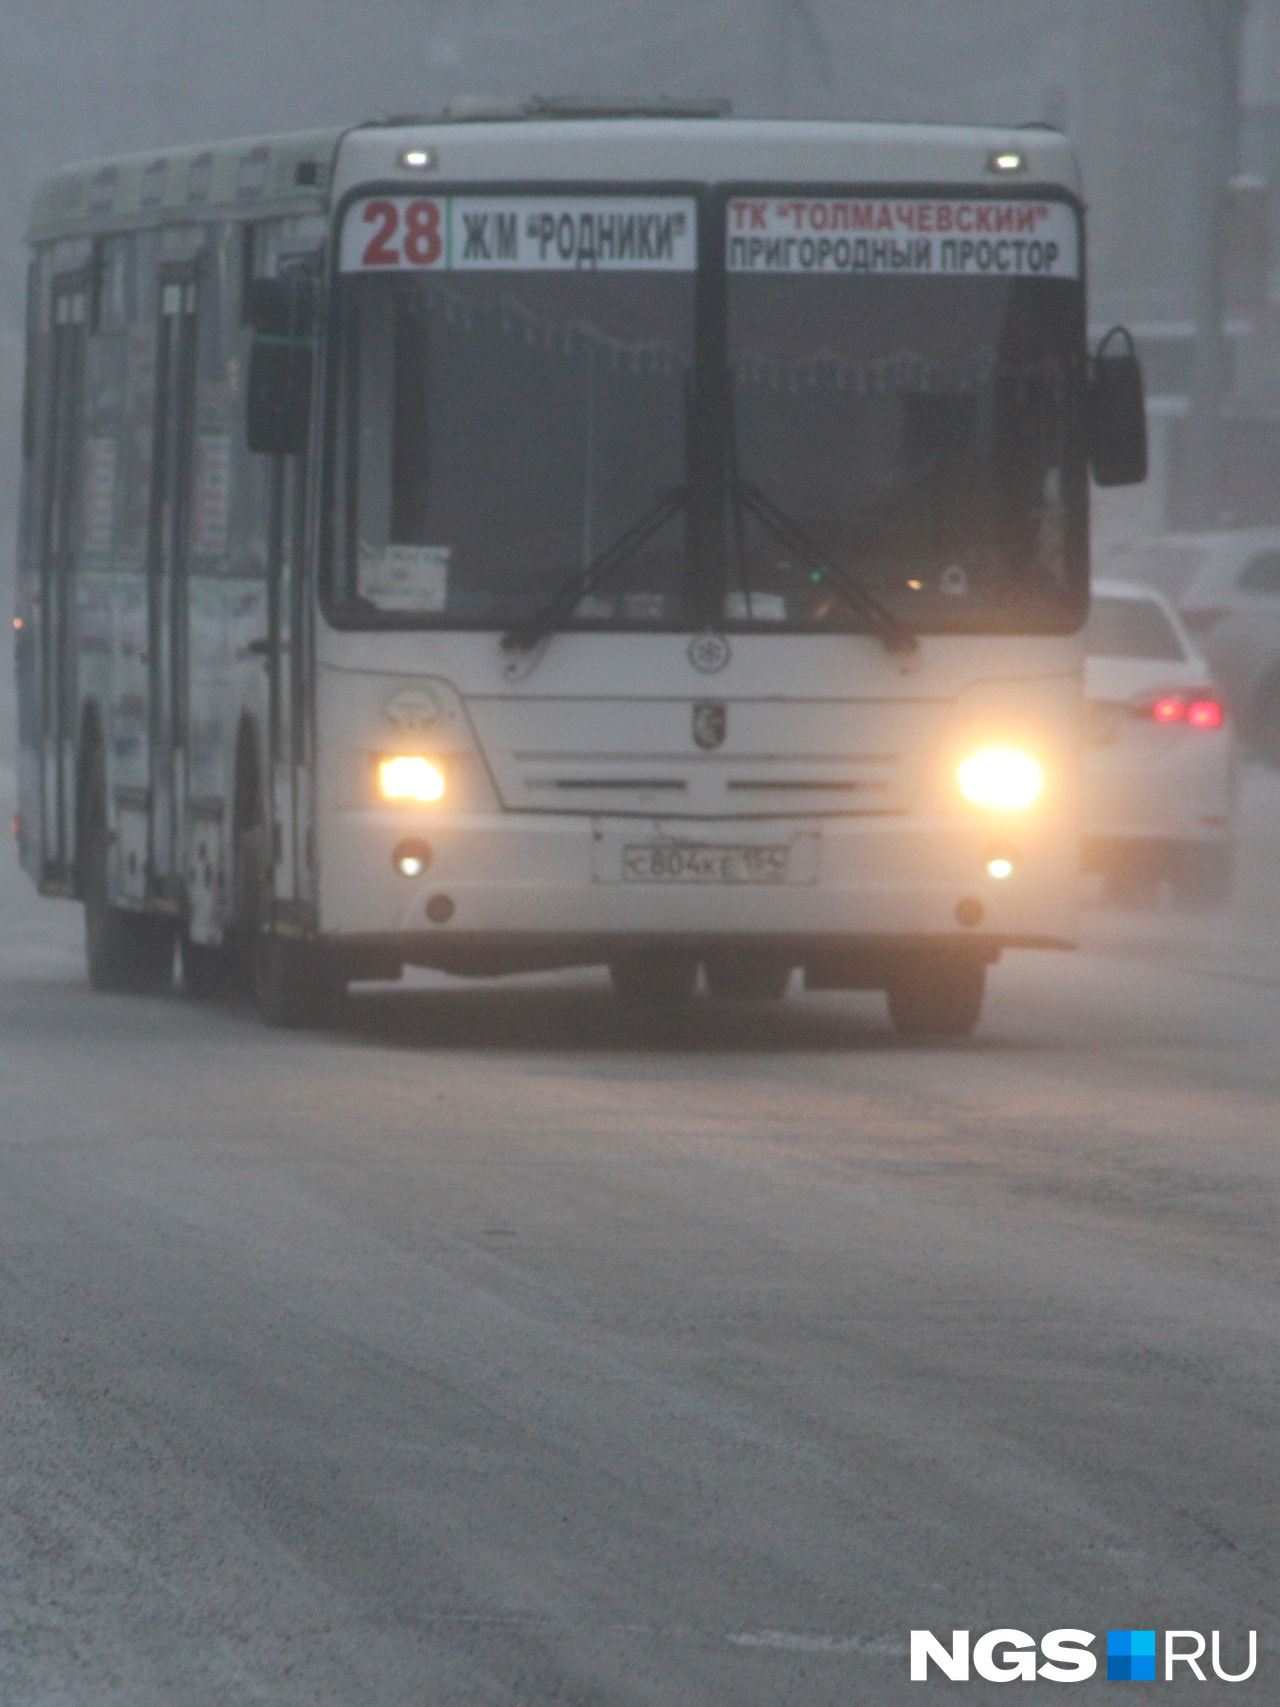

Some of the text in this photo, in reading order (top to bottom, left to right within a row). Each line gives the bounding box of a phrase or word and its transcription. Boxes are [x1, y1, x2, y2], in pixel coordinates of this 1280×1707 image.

[361, 200, 443, 265] 28
[462, 212, 518, 260] ЖМ
[730, 202, 767, 231] ТК
[939, 238, 1060, 274] ПРОСТОР
